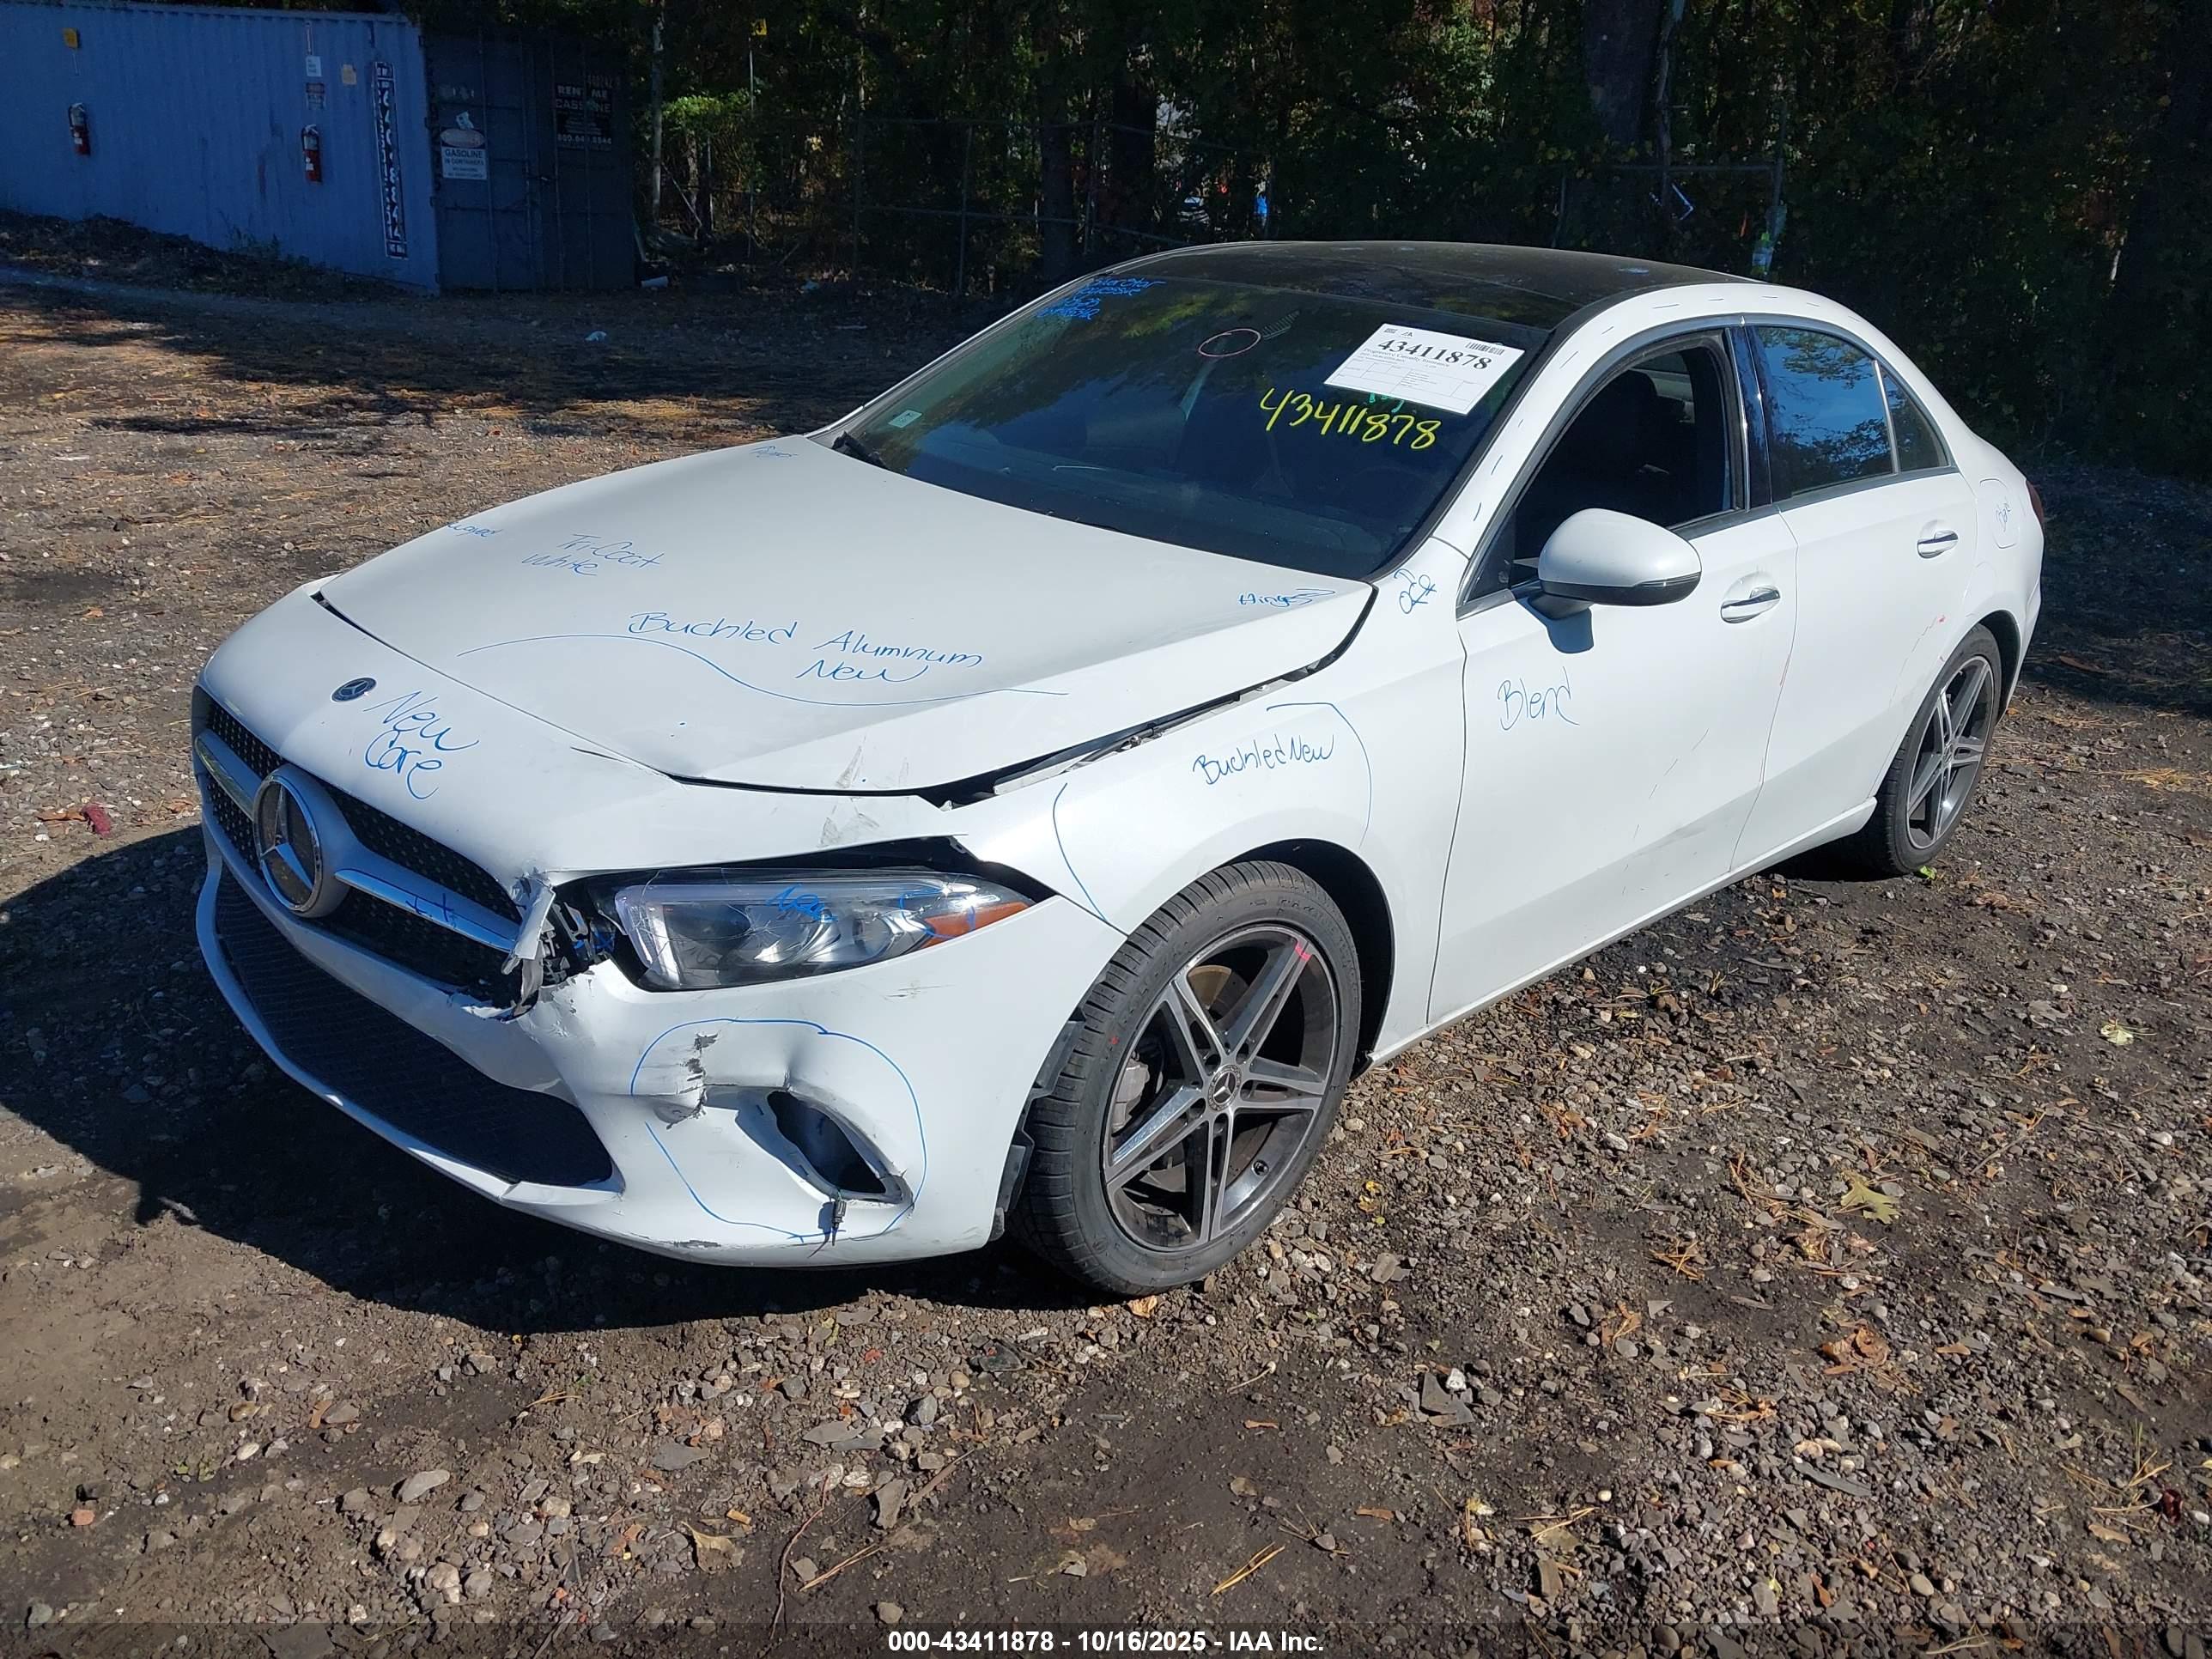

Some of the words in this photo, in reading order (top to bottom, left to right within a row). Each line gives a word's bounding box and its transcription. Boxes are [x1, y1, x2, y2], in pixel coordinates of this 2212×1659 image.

[557, 85, 584, 96] RENT
[445, 149, 483, 159] GASOLINE
[1377, 338, 1492, 370] 43411878
[1260, 388, 1440, 449] 43411878
[795, 659, 929, 683] New
[1497, 666, 1581, 731] Blend
[363, 690, 479, 751] New
[1290, 734, 1334, 763] New
